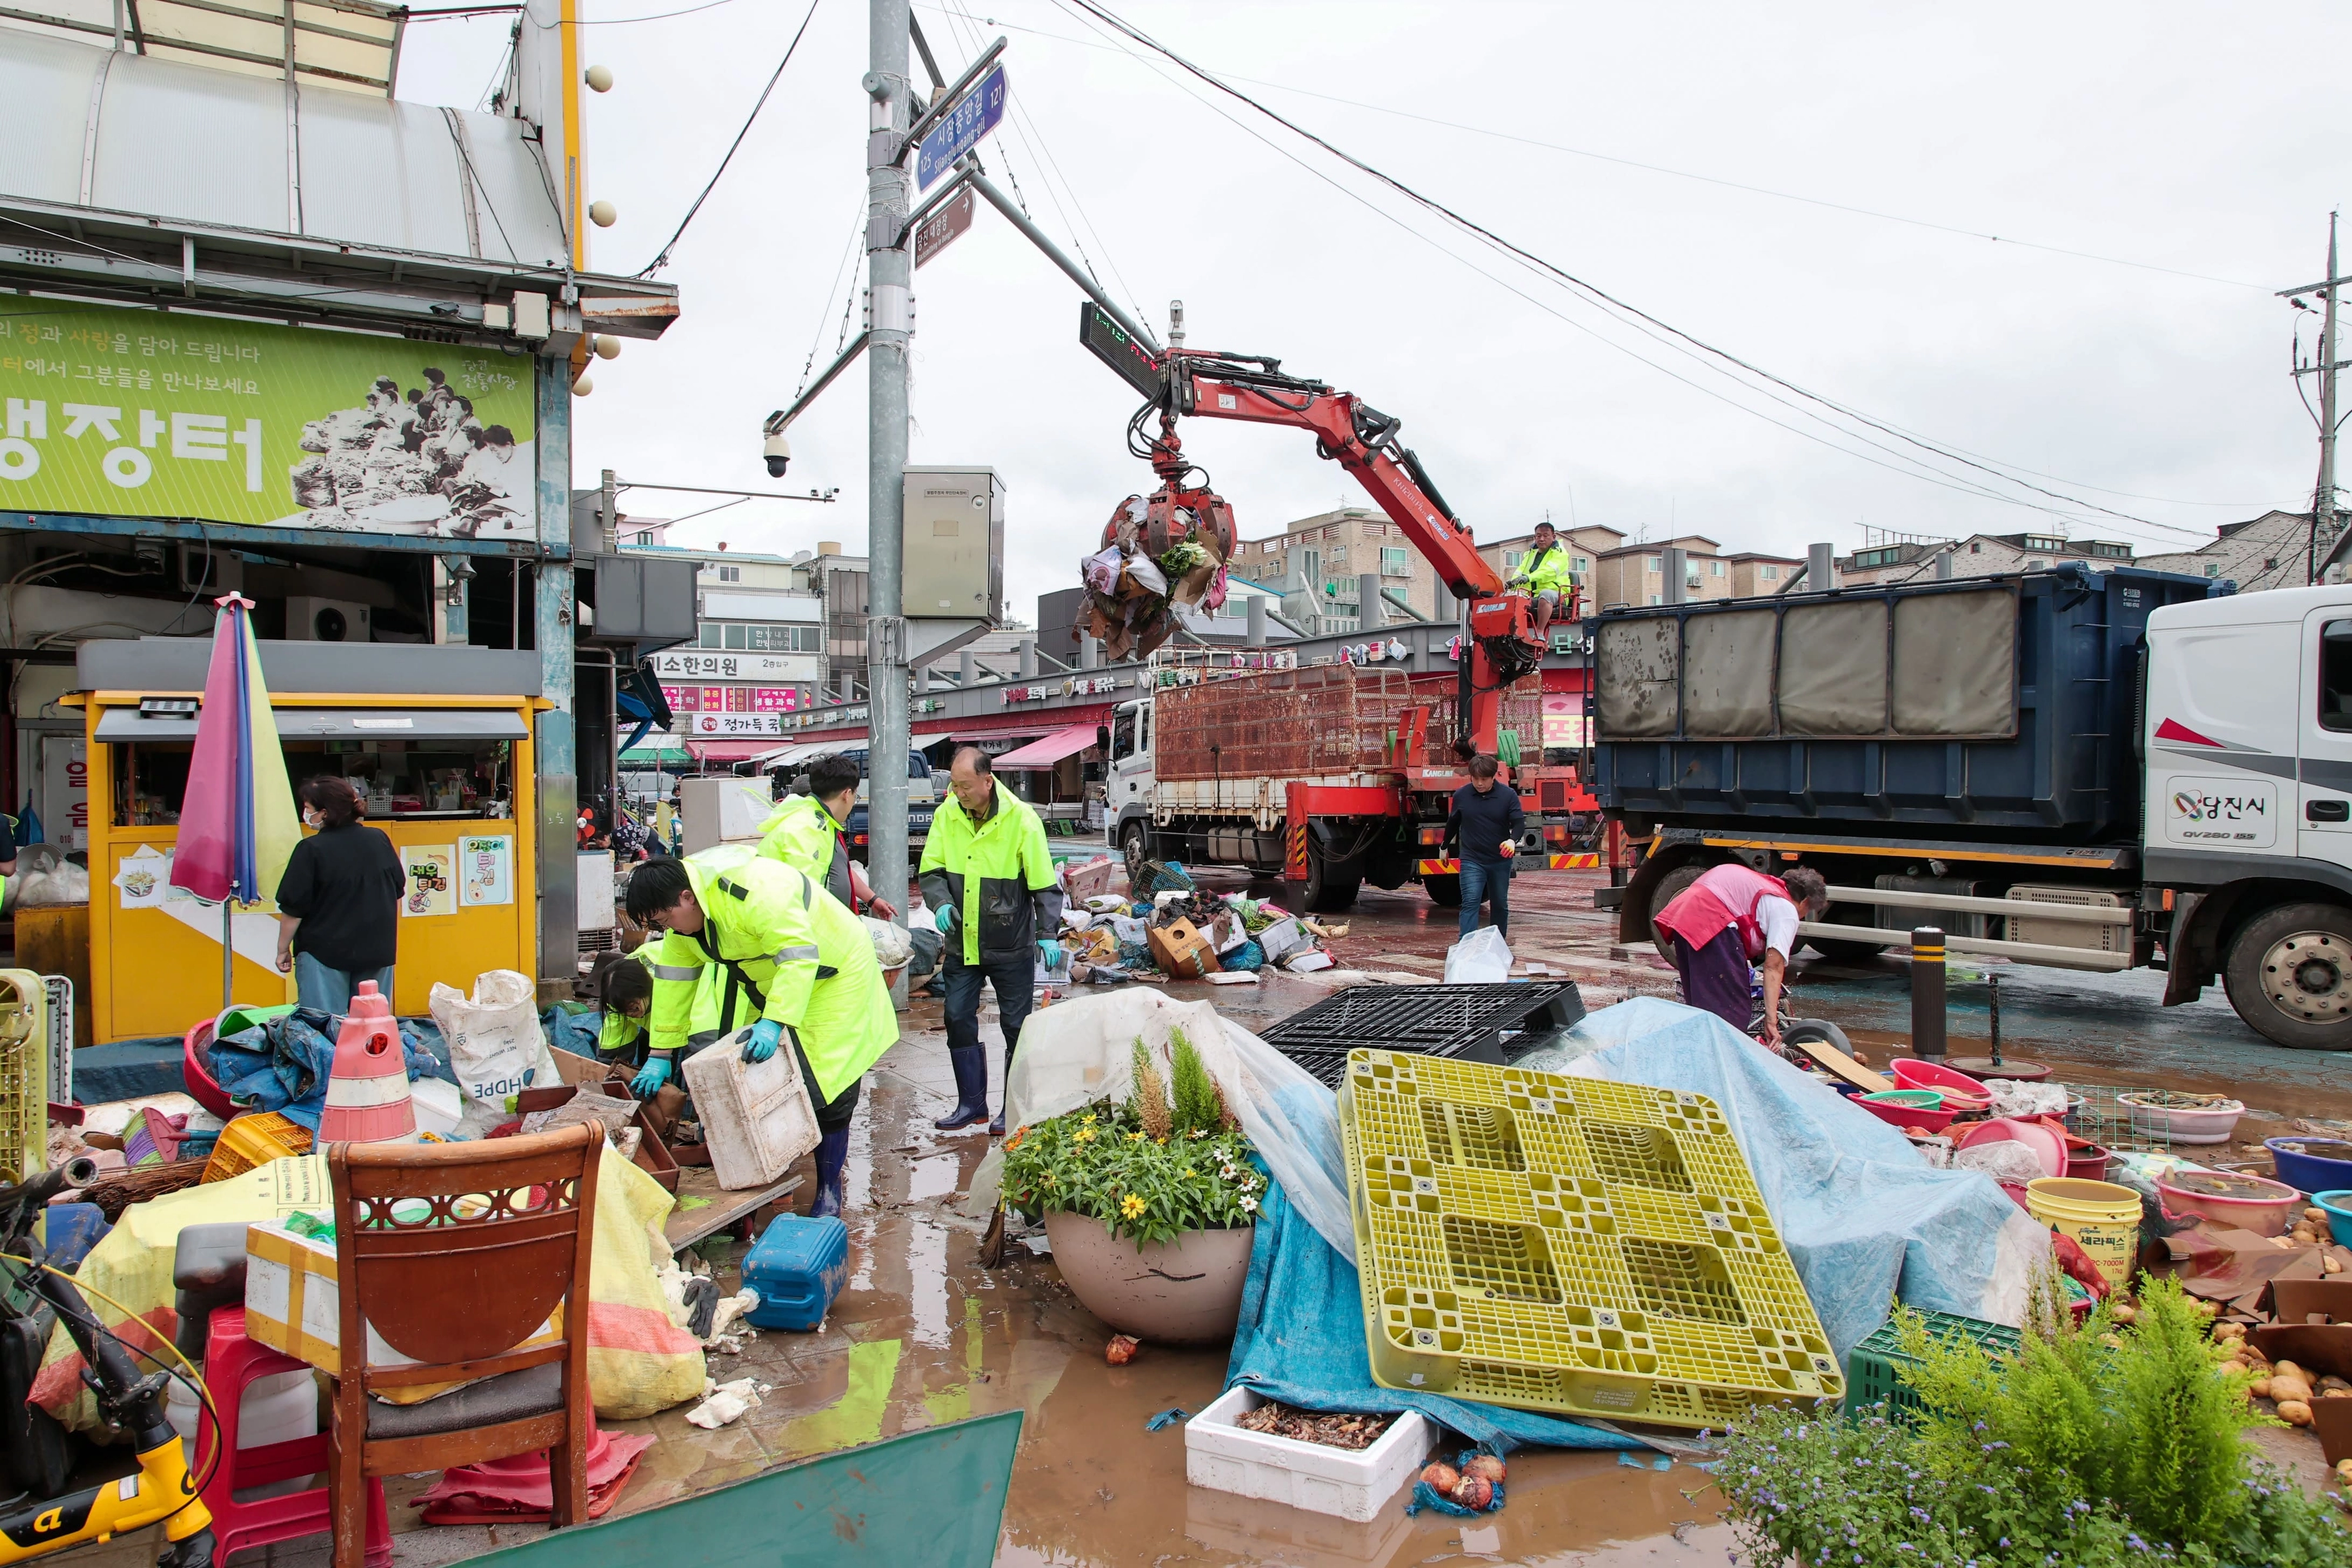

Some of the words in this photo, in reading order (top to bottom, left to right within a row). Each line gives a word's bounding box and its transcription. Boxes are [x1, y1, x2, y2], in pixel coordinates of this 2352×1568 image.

[990, 83, 1002, 109] 121
[937, 89, 983, 146] 시장중앙길
[934, 116, 985, 175] Sijangjungang-gil
[920, 152, 931, 175] 125
[917, 228, 928, 252] 당진
[19, 323, 63, 345] 정과
[68, 328, 131, 354] 사랑을
[138, 335, 179, 357] 담아
[184, 342, 260, 363] 드립니다
[75, 365, 154, 390] 그분들을
[162, 371, 260, 395] 만나보세요
[1476, 602, 1508, 614] KANGLIM
[763, 658, 789, 668] 2층입구
[704, 690, 720, 698] 통증
[704, 701, 720, 710] 완화
[753, 697, 796, 707] 생활과학
[702, 718, 717, 730] 국밥
[724, 718, 763, 732] 정가득
[1422, 768, 1454, 777] KANGLIM
[2203, 796, 2264, 820] 당진시
[2183, 831, 2231, 839] QV280
[467, 839, 505, 852] 오징어
[409, 862, 438, 877] 새우
[476, 852, 495, 886] 튀김
[417, 877, 446, 891] 튀김
[475, 1077, 522, 1098] HDPE
[2080, 1236, 2124, 1246] 세라픽스
